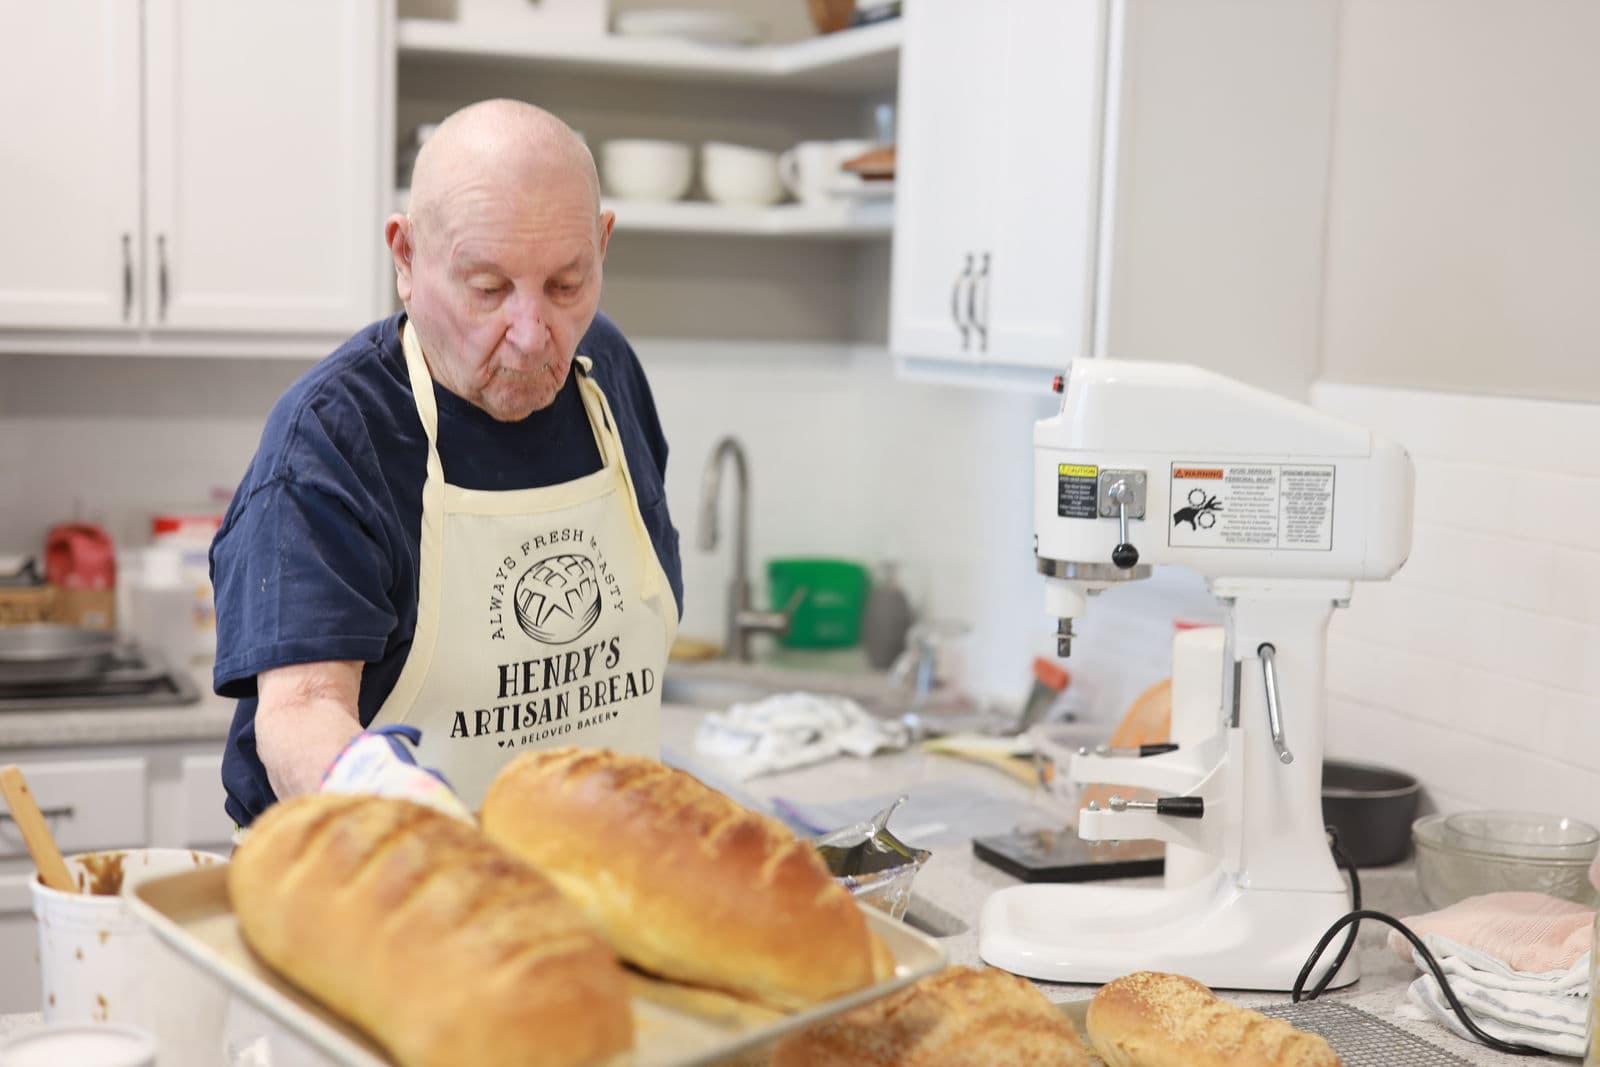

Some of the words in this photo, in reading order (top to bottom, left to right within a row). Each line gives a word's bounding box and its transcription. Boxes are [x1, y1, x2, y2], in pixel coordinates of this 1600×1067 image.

[1183, 471, 1223, 479] WARNING
[489, 556, 516, 640] ALWAYS
[521, 528, 584, 556] FRESH
[496, 636, 621, 699] HENRY'S
[450, 691, 570, 739] ARTISAN
[579, 667, 655, 713] BREAD
[507, 739, 515, 748] A
[521, 724, 572, 746] BELOVED
[577, 713, 611, 730] BAKER
